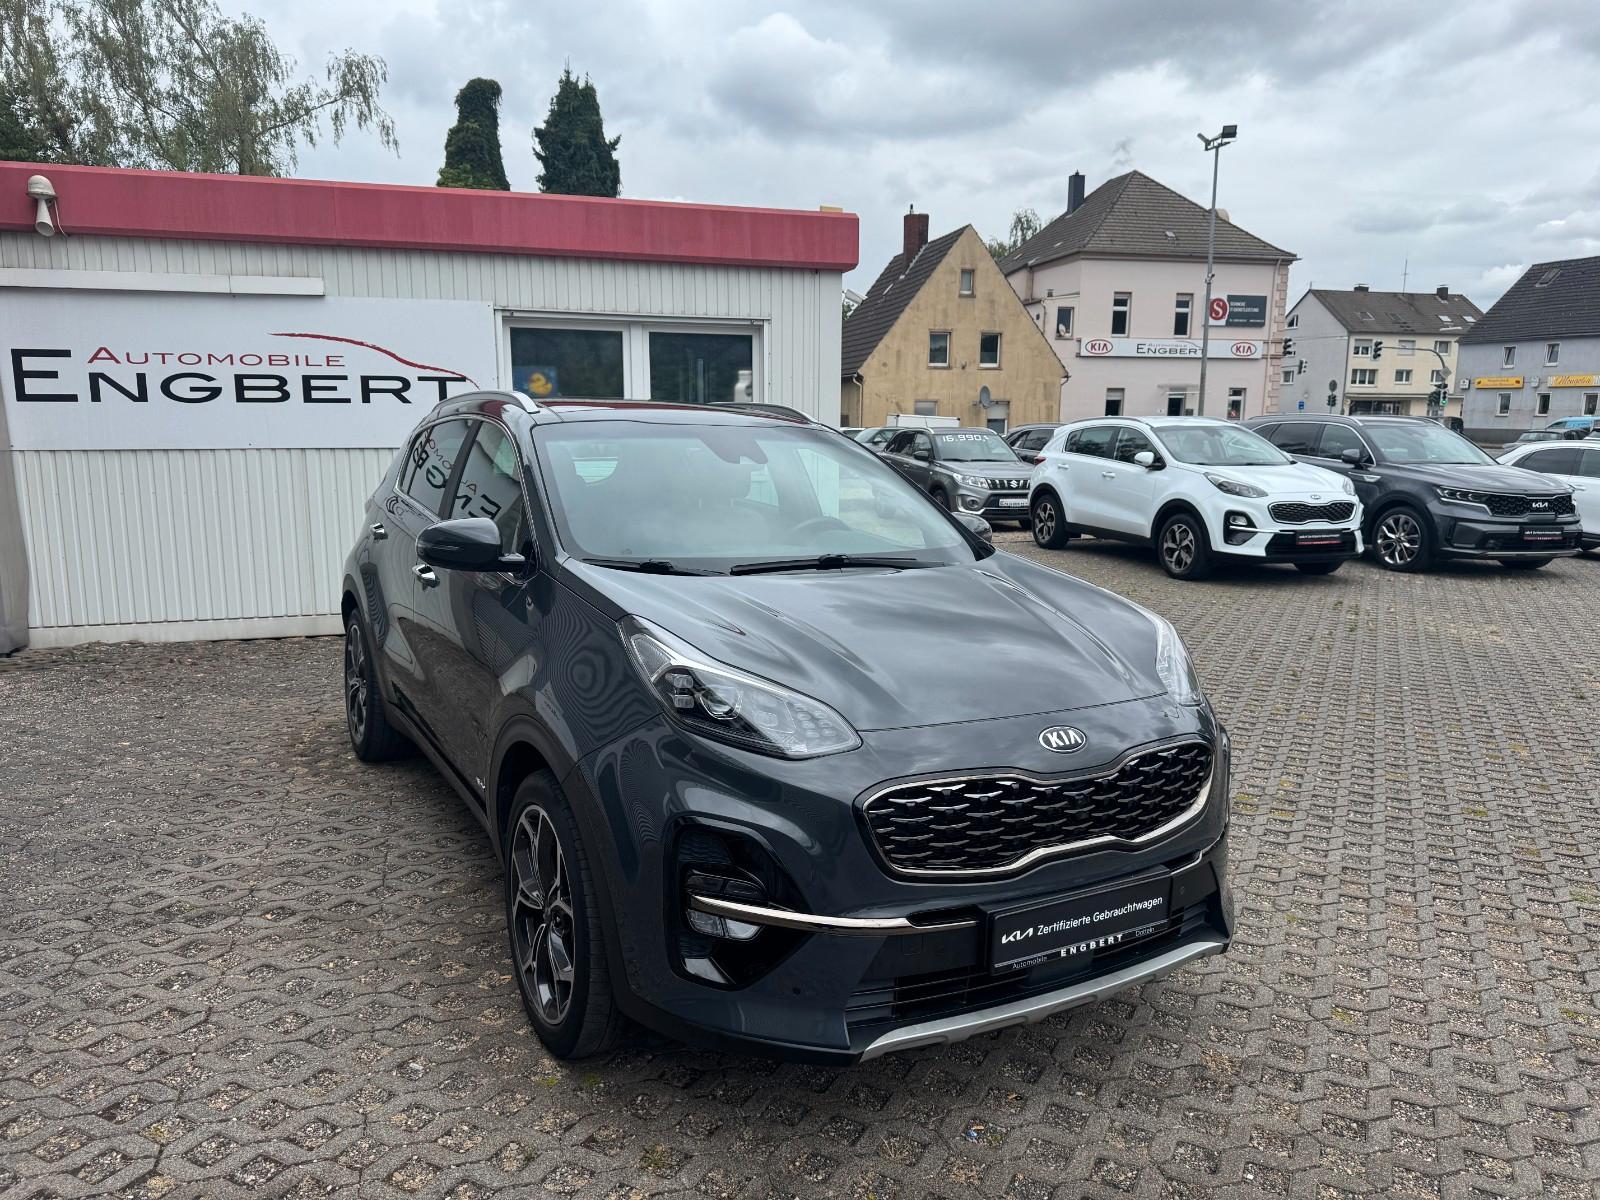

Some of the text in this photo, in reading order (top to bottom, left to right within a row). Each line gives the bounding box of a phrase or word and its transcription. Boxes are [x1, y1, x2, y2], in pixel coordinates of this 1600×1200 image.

[88, 346, 346, 368] AUTOMOBILE
[1090, 343, 1109, 352] KIA
[1235, 345, 1253, 354] KIA
[10, 348, 467, 404] ENGBERT
[1045, 729, 1082, 748] KIA
[1001, 896, 1163, 944] KIA Zertifizierte Gebrauchtwagen
[1060, 934, 1124, 957] ENGBERT
